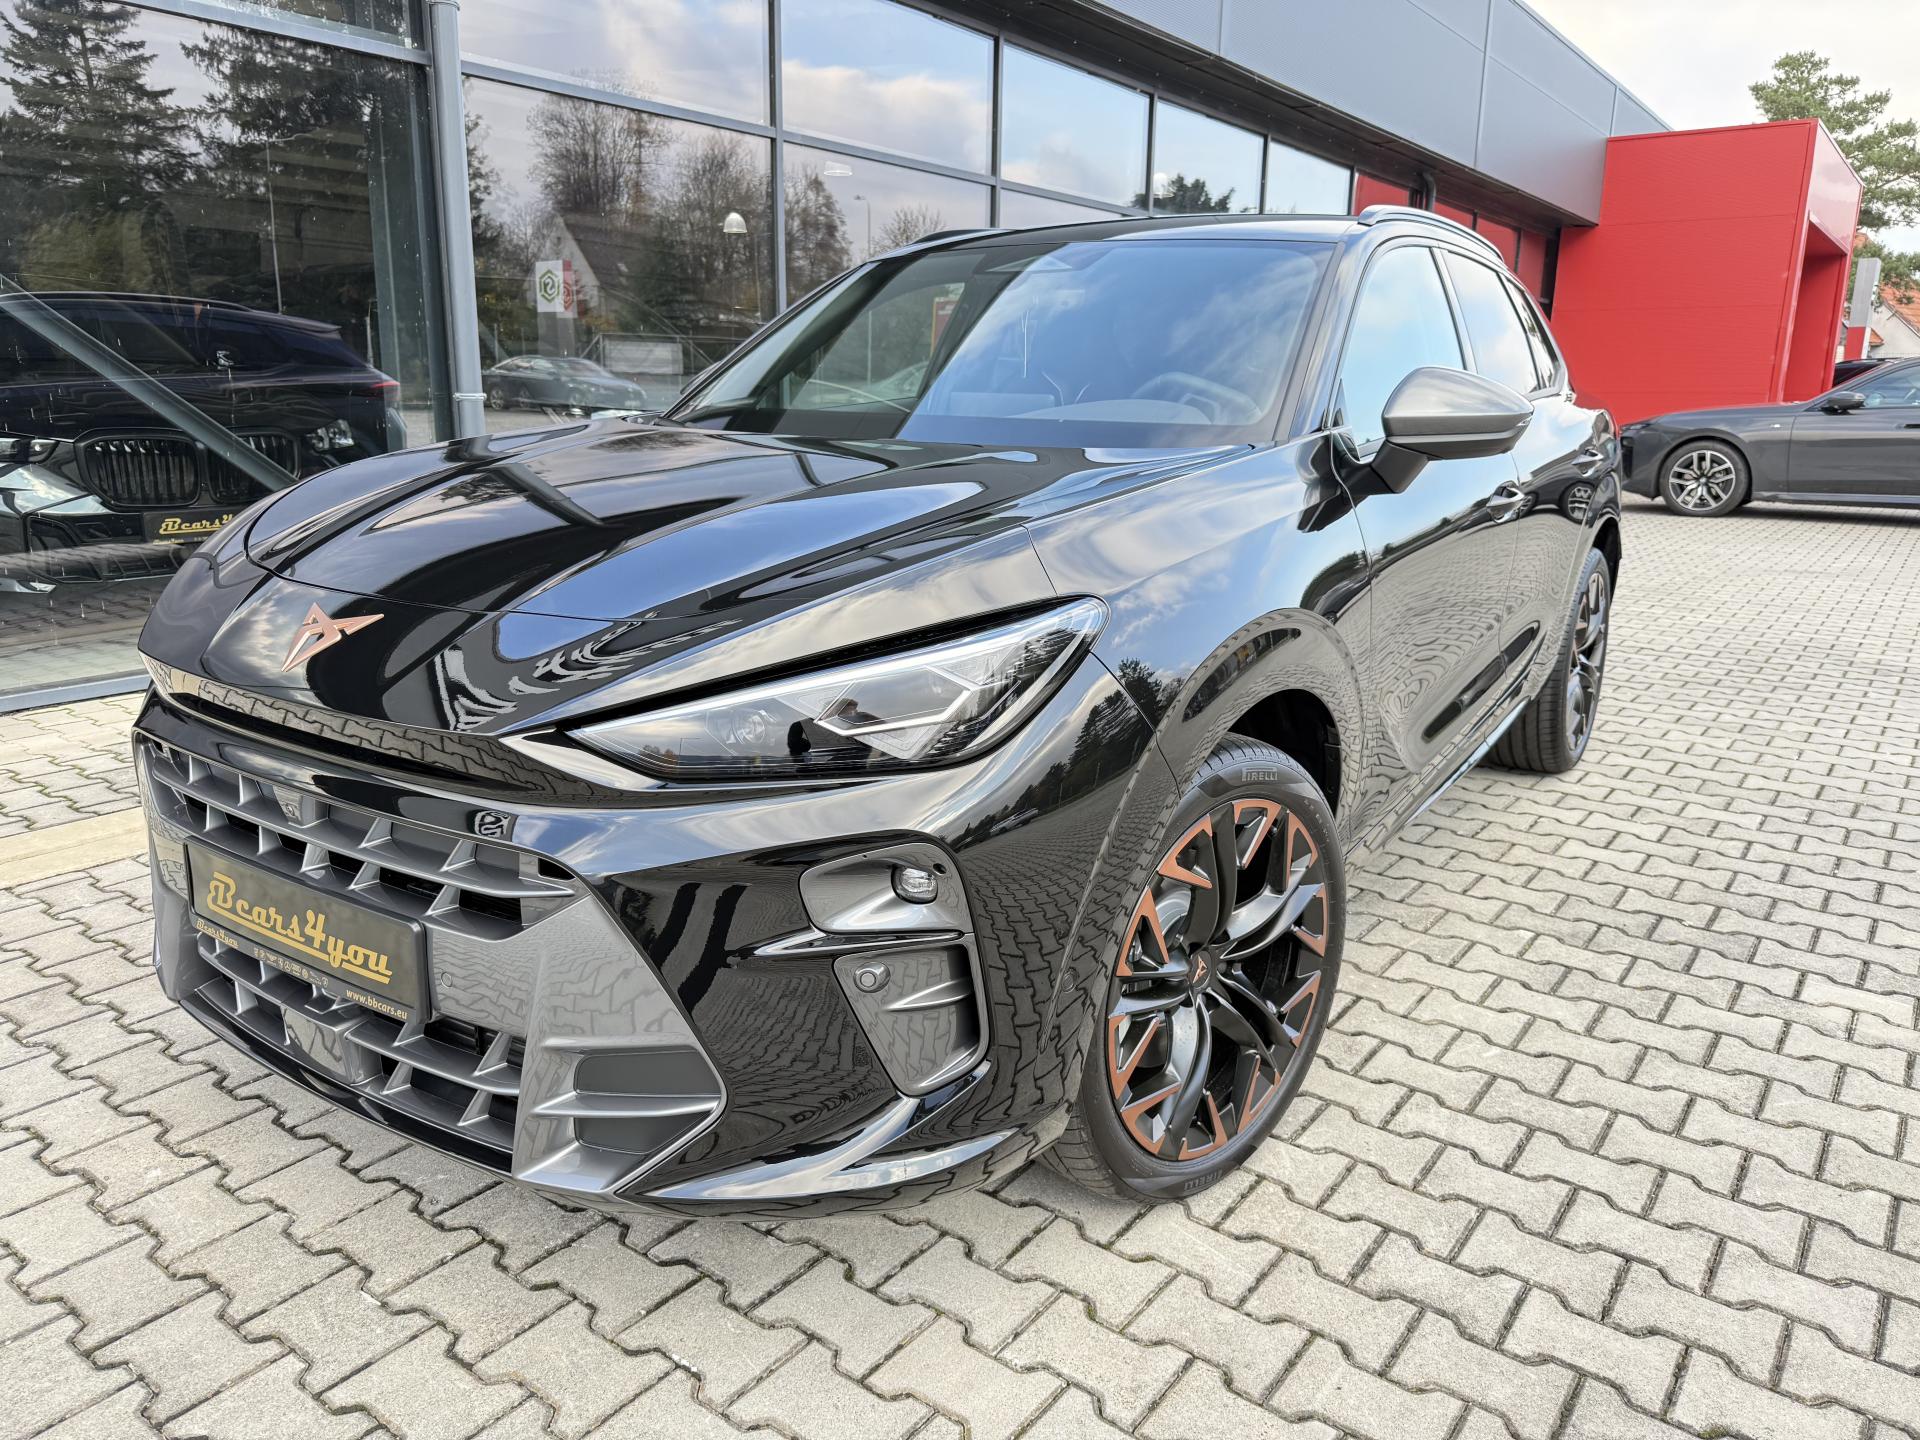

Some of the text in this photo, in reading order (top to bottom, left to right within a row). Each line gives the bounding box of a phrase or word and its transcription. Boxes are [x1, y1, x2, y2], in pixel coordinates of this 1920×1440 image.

[1241, 766, 1278, 782] PIRELLI
[207, 872, 393, 984] Bcars4you
[346, 989, 408, 1020] www.bbcars.eu
